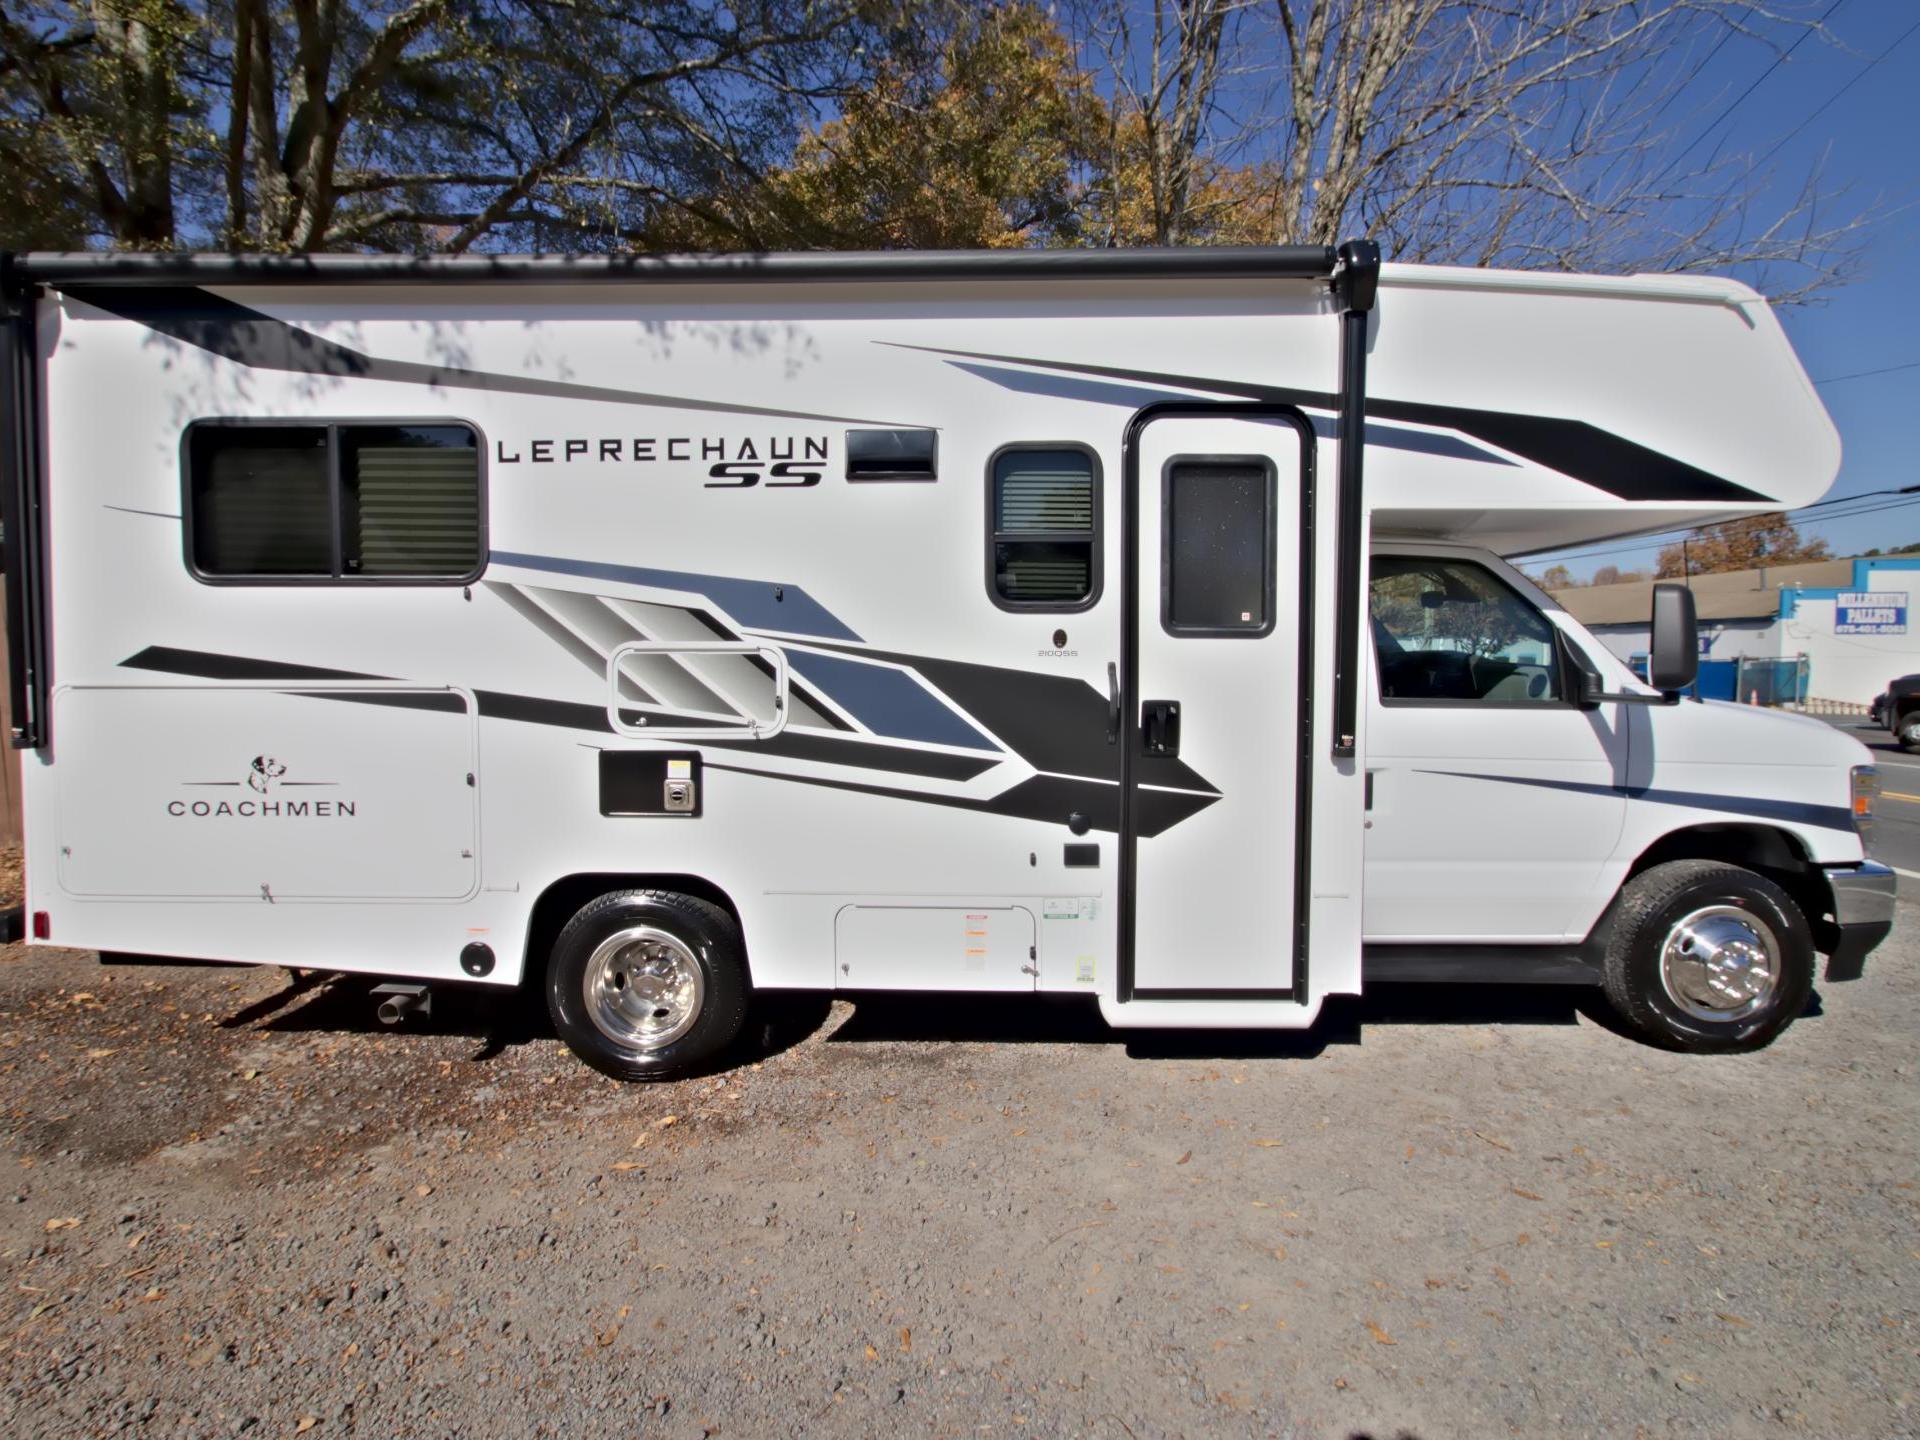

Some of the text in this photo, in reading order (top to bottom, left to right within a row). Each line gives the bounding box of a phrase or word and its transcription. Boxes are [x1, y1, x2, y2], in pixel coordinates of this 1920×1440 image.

[497, 436, 828, 463] LEPRECHAUN
[704, 462, 828, 488] SS
[1846, 608, 1897, 624] PALLETS
[167, 800, 358, 818] COACHMEN
